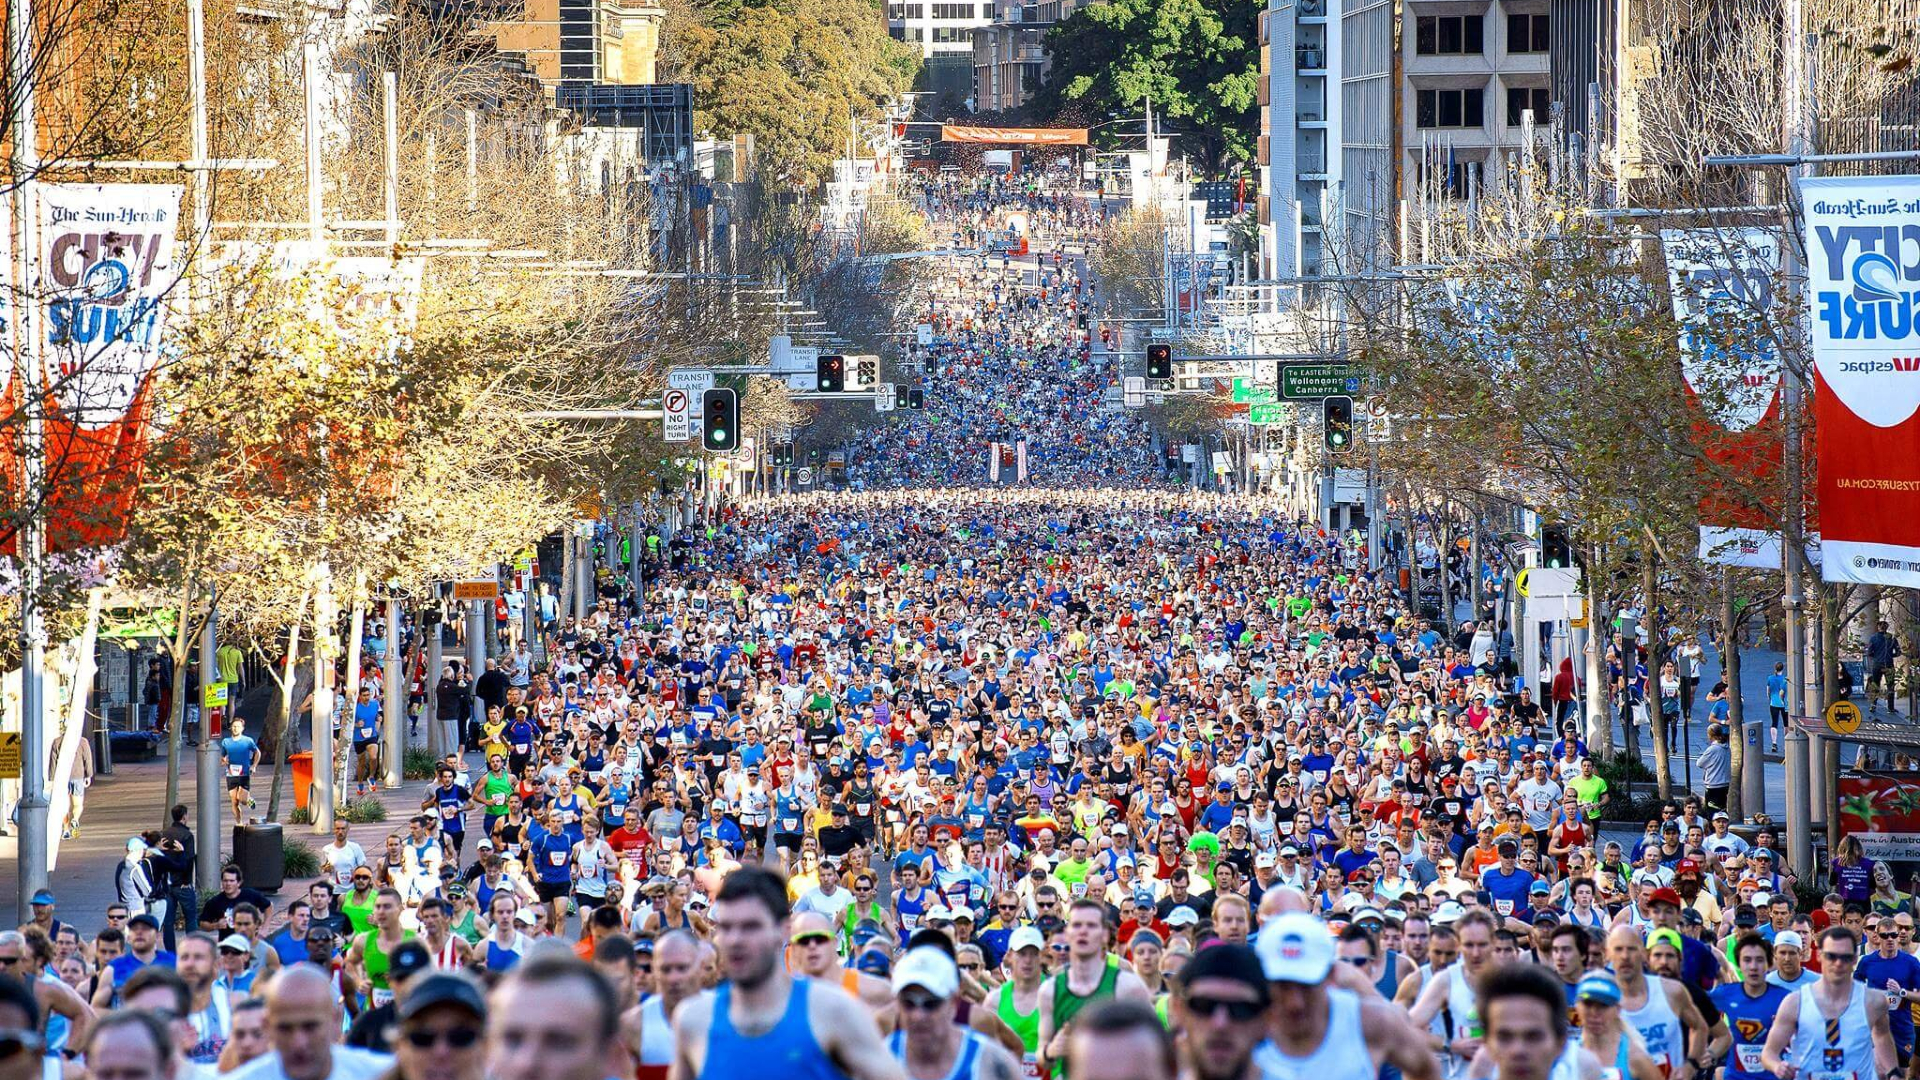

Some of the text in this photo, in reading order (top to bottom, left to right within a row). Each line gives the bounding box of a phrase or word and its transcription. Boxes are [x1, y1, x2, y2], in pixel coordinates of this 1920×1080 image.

[51, 206, 79, 222] The
[51, 232, 162, 287] CITY
[1290, 378, 1344, 387] Wollongong
[1295, 386, 1338, 394] Canberra
[1865, 848, 1891, 857] Picked
[1892, 849, 1904, 860] for
